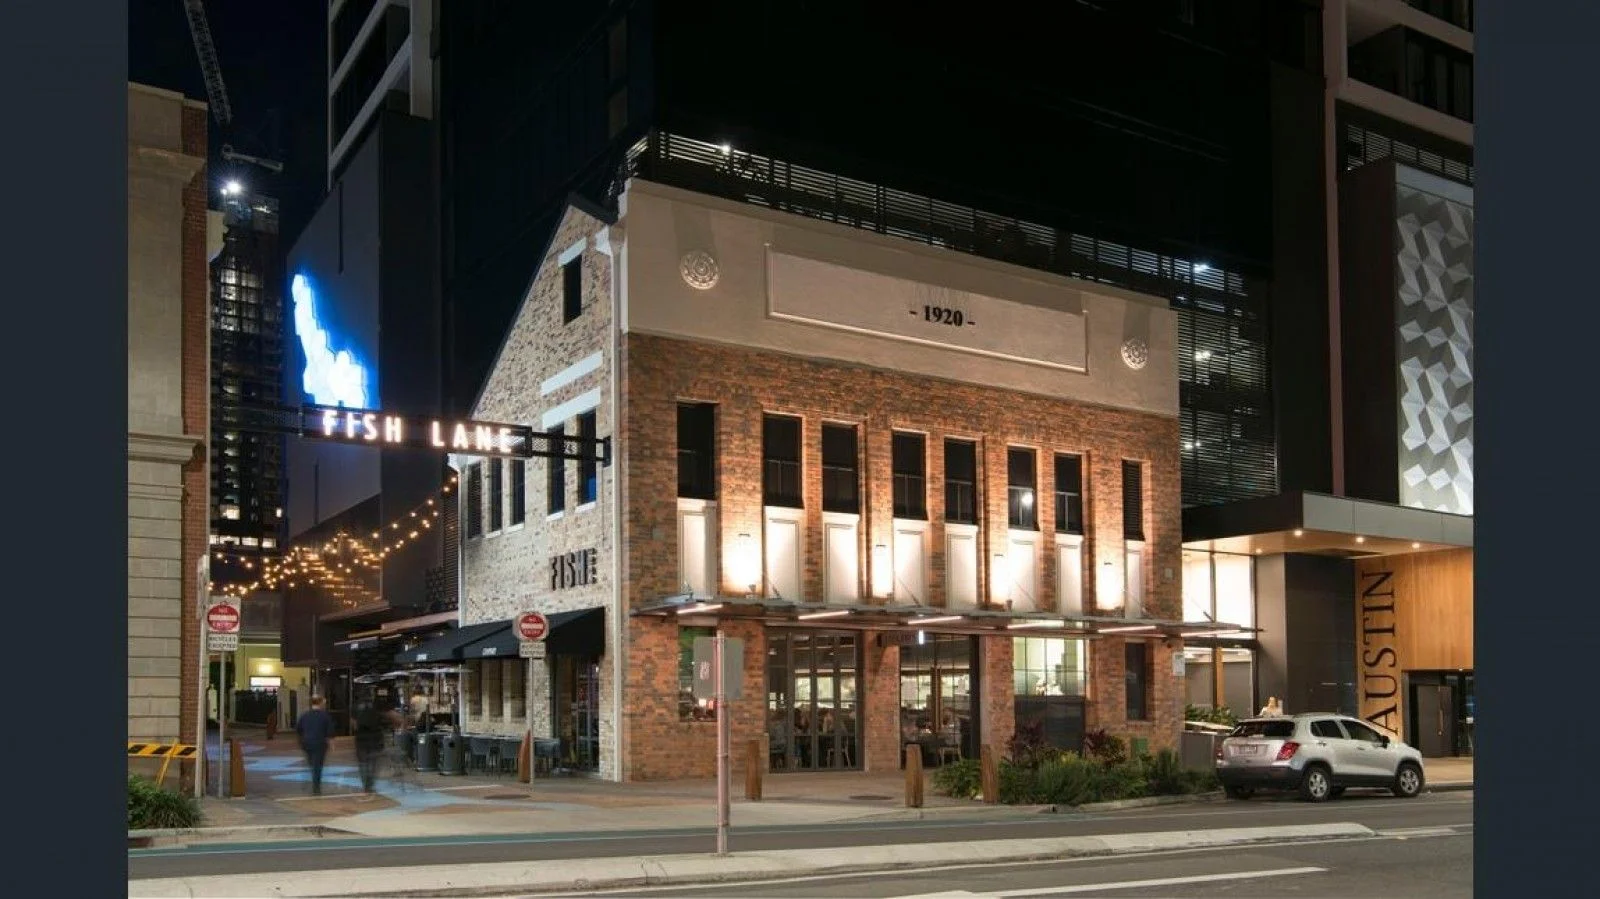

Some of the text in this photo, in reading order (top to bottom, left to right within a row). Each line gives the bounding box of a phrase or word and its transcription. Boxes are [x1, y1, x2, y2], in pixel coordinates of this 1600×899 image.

[924, 305, 963, 327] 1920
[322, 409, 512, 453] FISH LANE
[1362, 570, 1398, 736] AUSTIN
